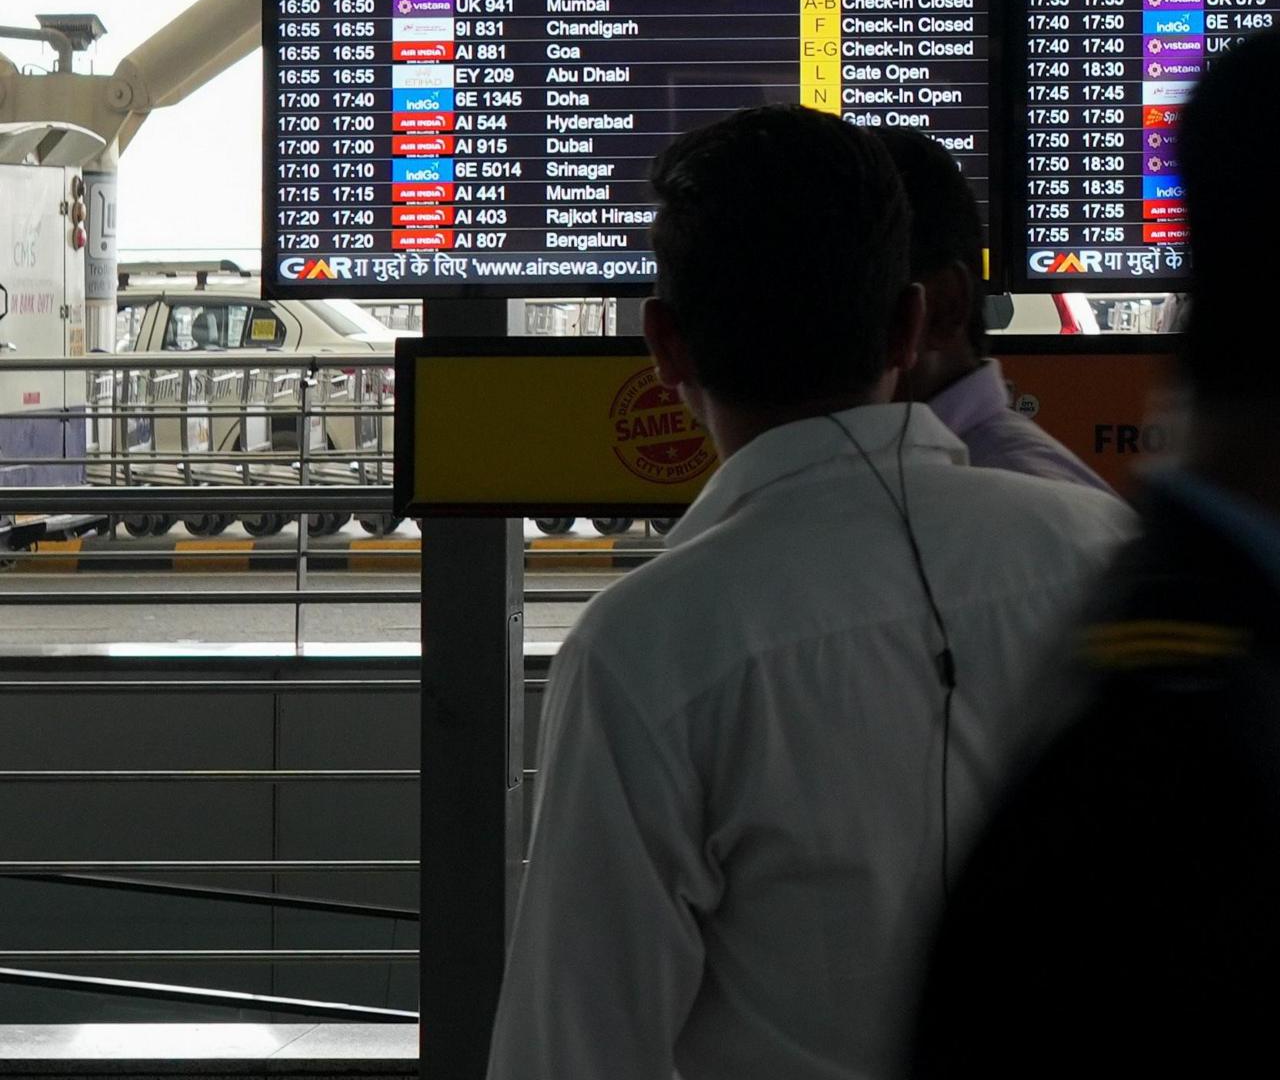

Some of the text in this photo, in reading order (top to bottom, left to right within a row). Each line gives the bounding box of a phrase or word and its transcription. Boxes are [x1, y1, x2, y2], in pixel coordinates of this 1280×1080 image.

[546, 67, 629, 82] Abu Dhabi
[842, 65, 929, 82] Gate Open
[615, 411, 686, 441] SAME
[1094, 424, 1167, 453] FRO
[636, 449, 708, 477] CITY PRICES
